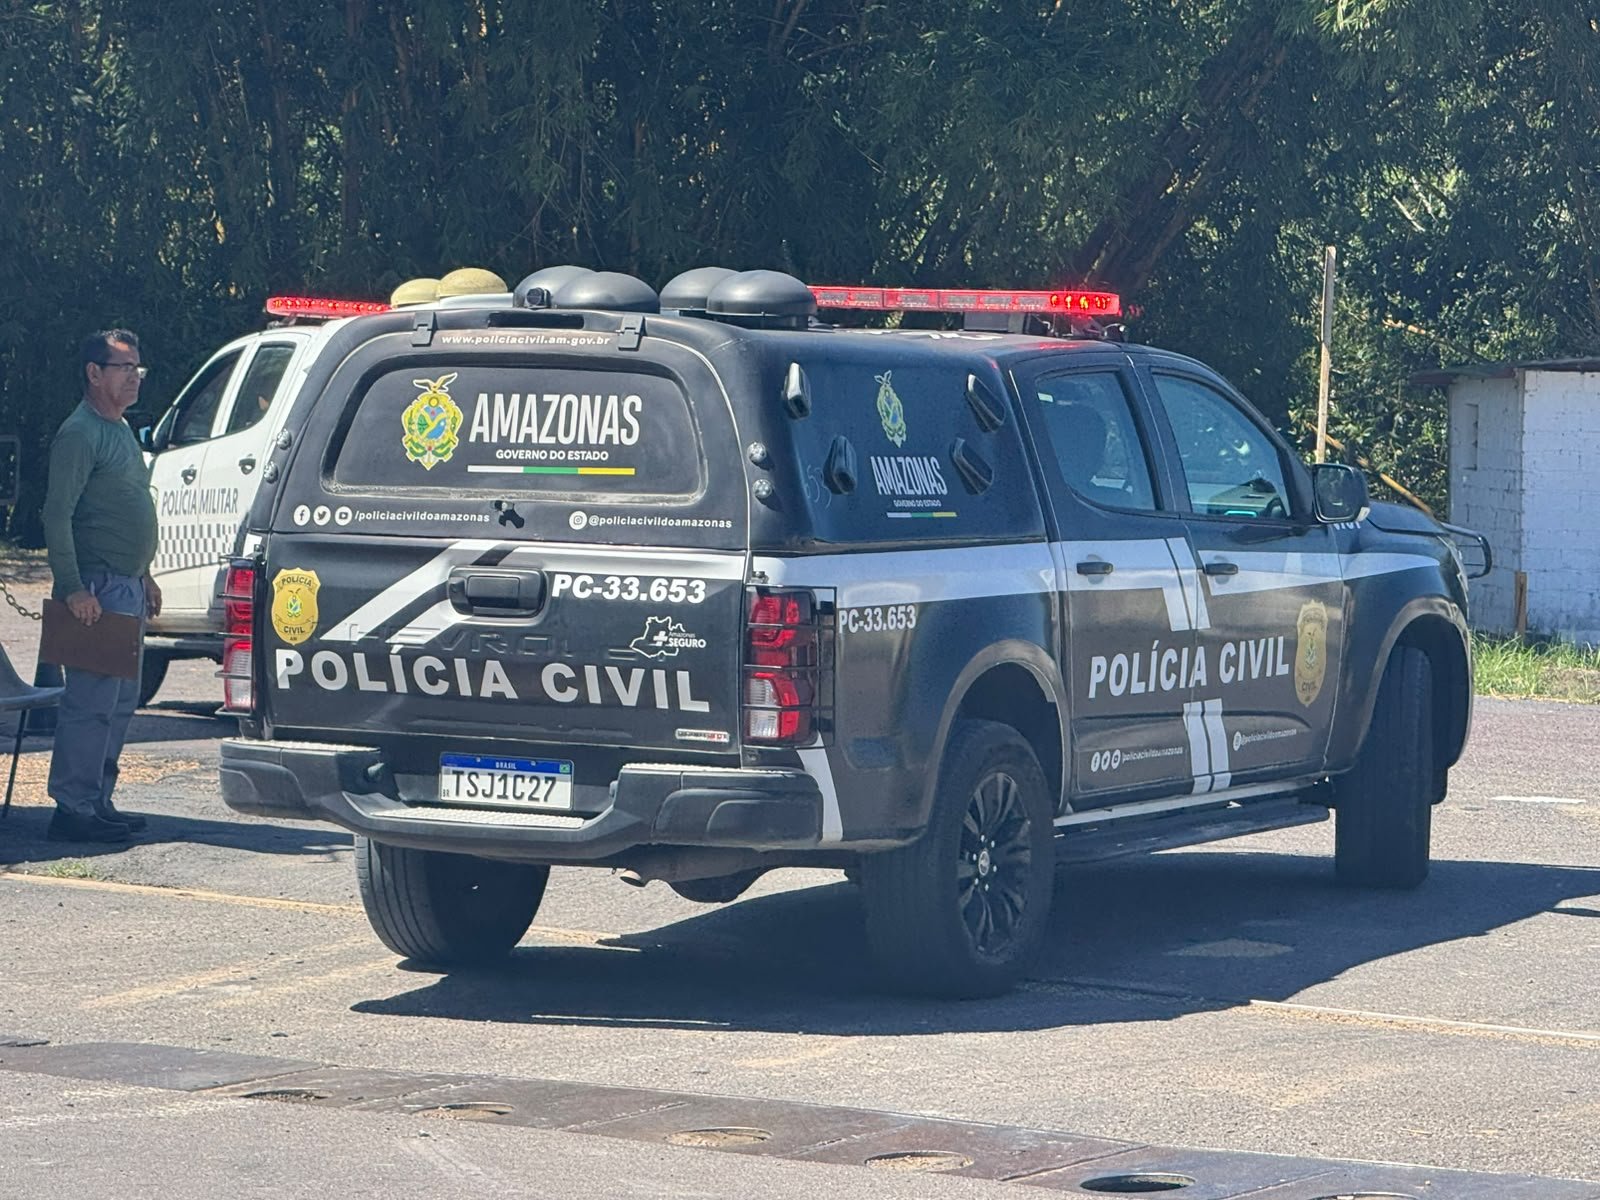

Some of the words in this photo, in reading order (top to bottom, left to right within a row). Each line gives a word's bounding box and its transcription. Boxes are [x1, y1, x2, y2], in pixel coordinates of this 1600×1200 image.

[441, 334, 612, 346] www.policiacivil.am.gov.br
[469, 392, 643, 446] AMAZONAS
[495, 449, 548, 461] GOVERNO
[549, 450, 567, 461] DO
[567, 450, 610, 462] ESTADO
[870, 456, 948, 495] AMAZONAS
[161, 484, 197, 516] POLÍCIA
[199, 488, 239, 514] MILITAR
[354, 509, 491, 523] /policiacivildoamazonas
[588, 514, 733, 529] @policiacivildoamazonas
[551, 574, 706, 603] PC-33.653
[283, 626, 305, 634] CIVIL
[838, 605, 917, 634] PC-33.653
[668, 638, 707, 648] SEGURO
[275, 647, 519, 698] POLÍCIA
[541, 663, 710, 713] CIVIL
[1088, 640, 1207, 699] POLÍCIA
[1219, 635, 1289, 684] CIVIL
[495, 761, 517, 770] BRASIL
[452, 770, 557, 802] TSJ1C27
